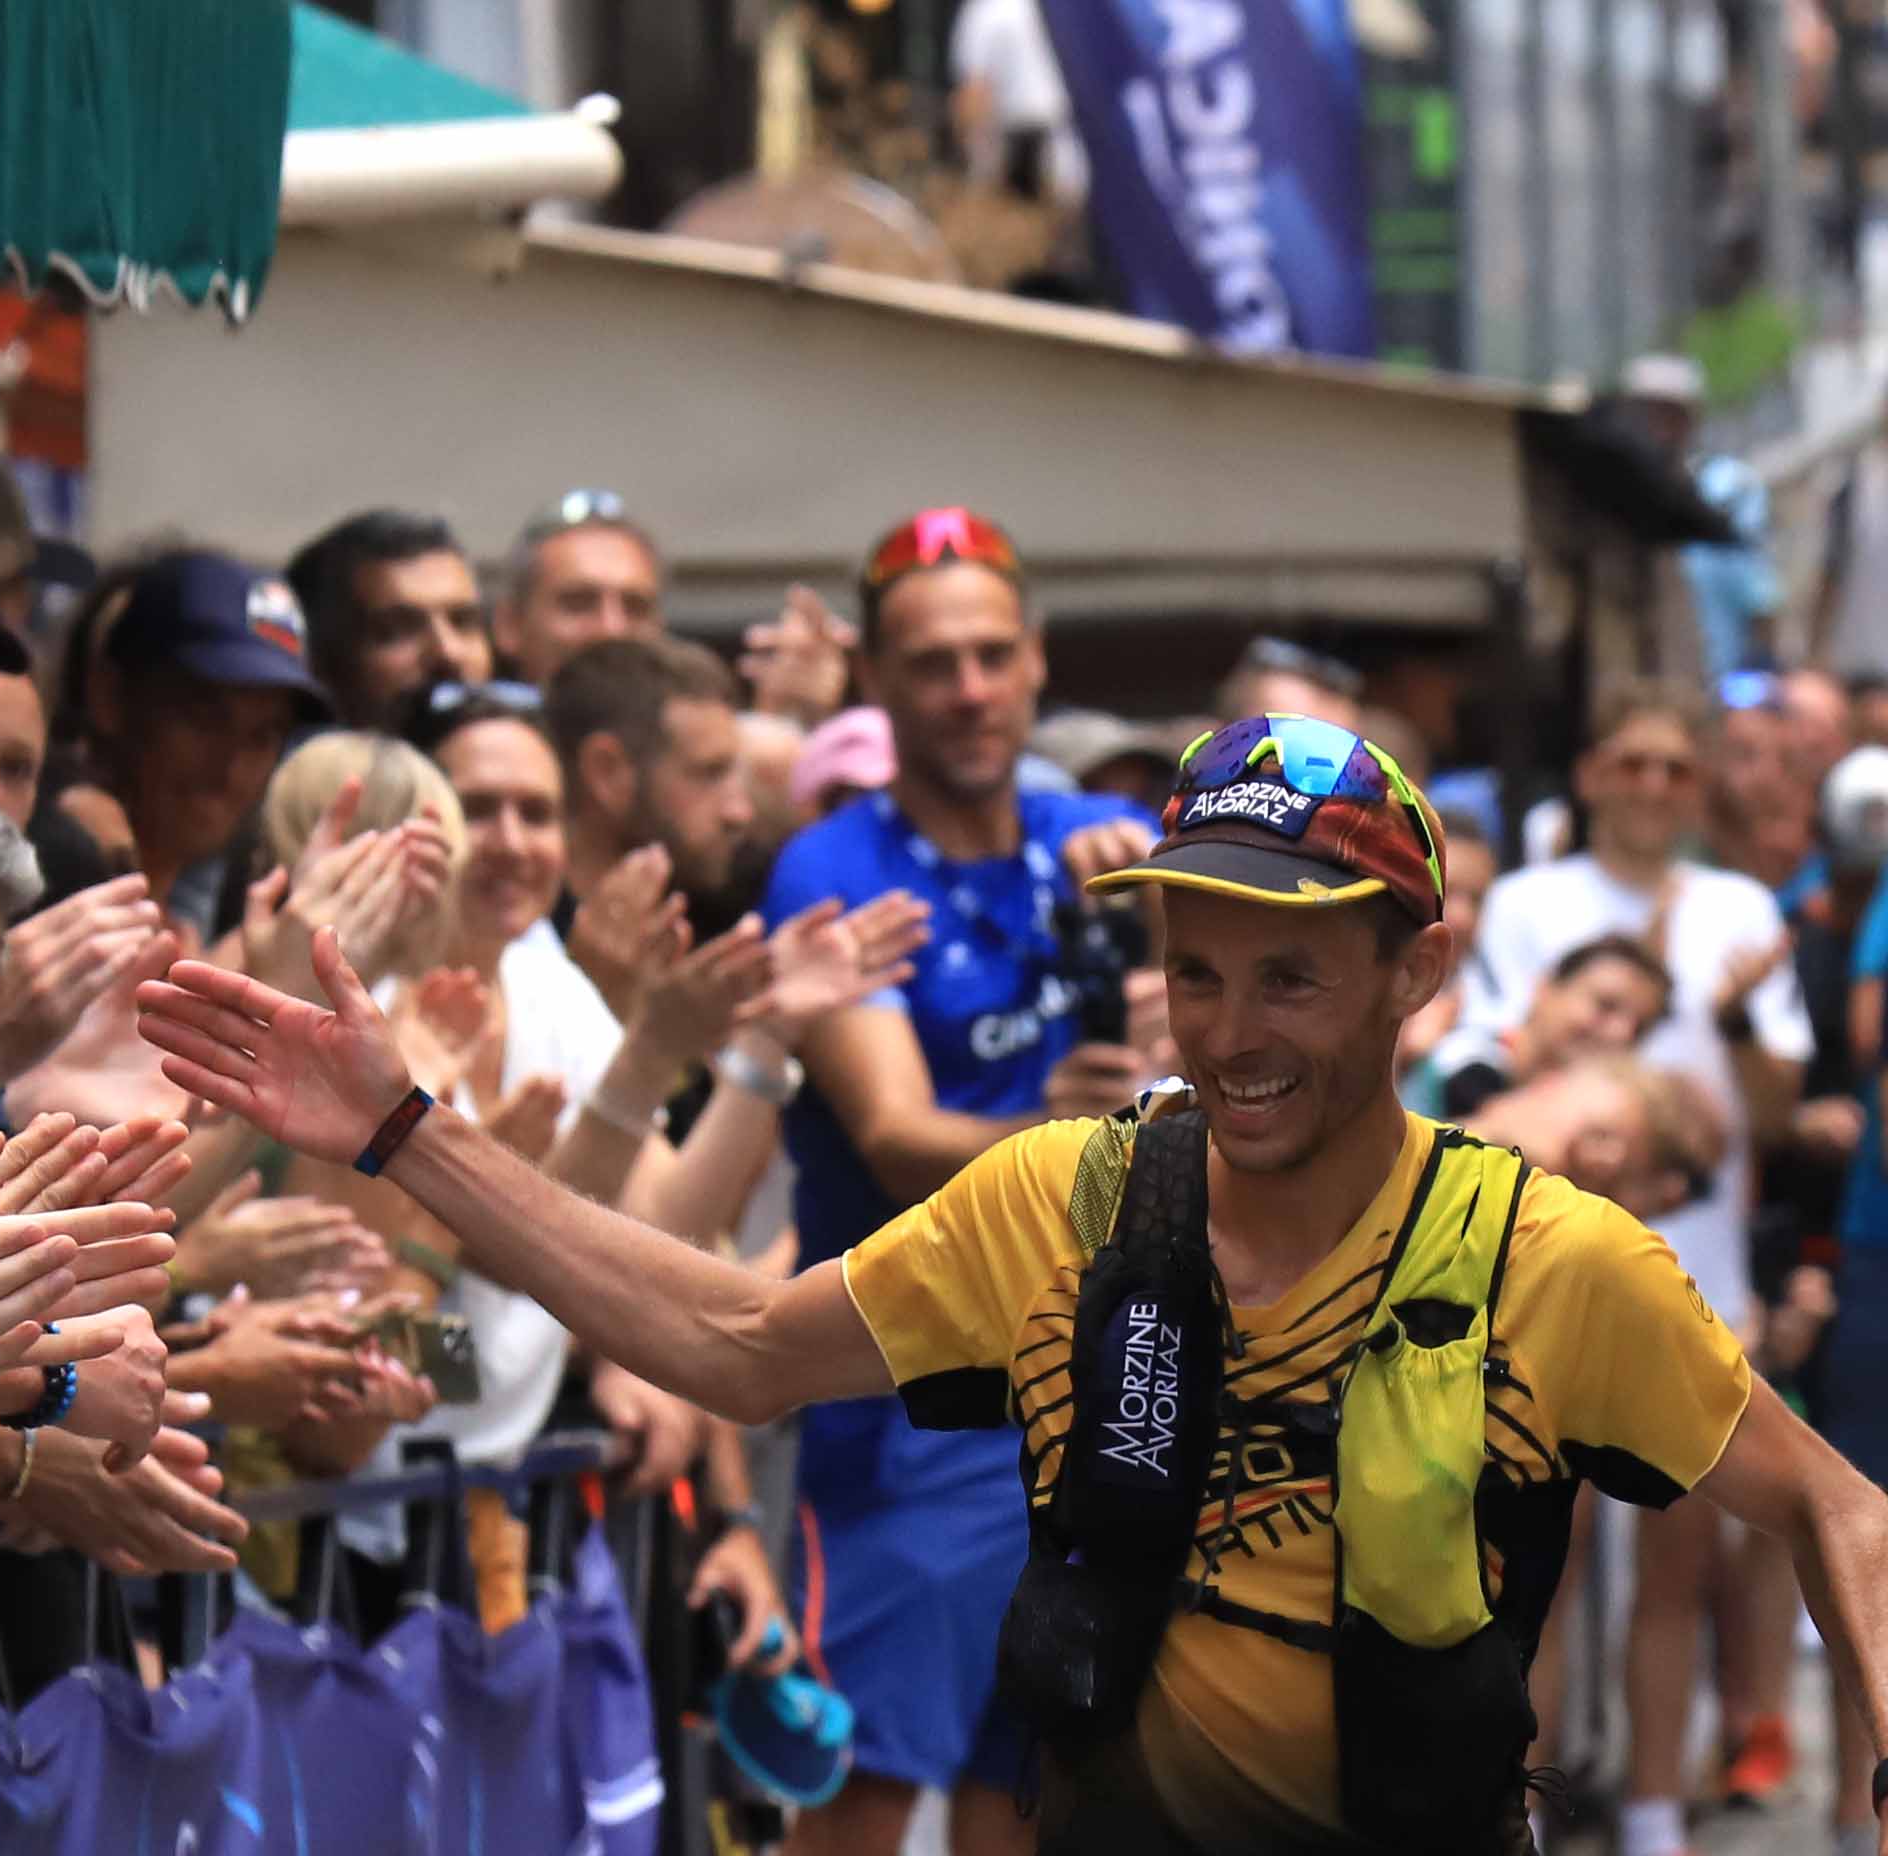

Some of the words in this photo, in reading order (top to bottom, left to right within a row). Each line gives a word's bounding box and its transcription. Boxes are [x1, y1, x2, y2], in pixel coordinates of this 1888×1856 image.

[1184, 790, 1289, 825] AVORIAZ
[1098, 1301, 1159, 1468] MORZINE
[1130, 1322, 1182, 1479] AVORIAZ
